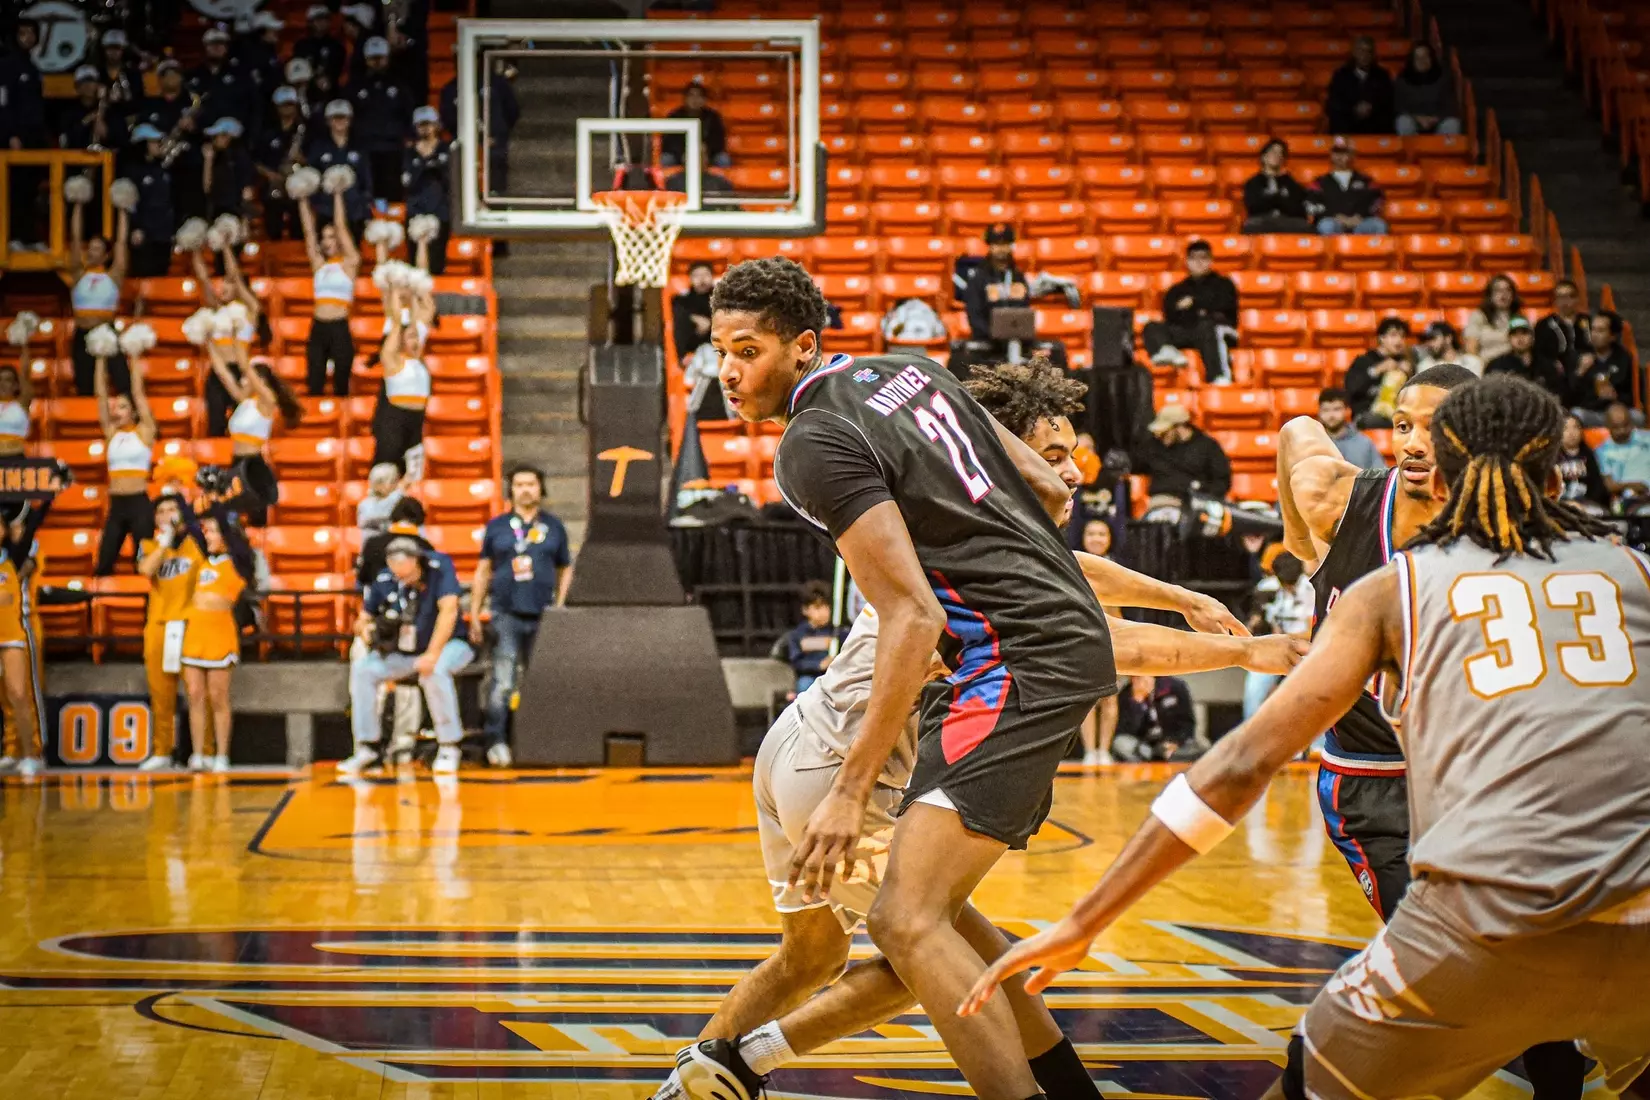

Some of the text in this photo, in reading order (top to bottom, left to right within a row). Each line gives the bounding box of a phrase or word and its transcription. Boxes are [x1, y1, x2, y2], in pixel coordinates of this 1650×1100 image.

[913, 390, 995, 504] 21
[1448, 571, 1638, 701] 33
[58, 702, 153, 765] 09
